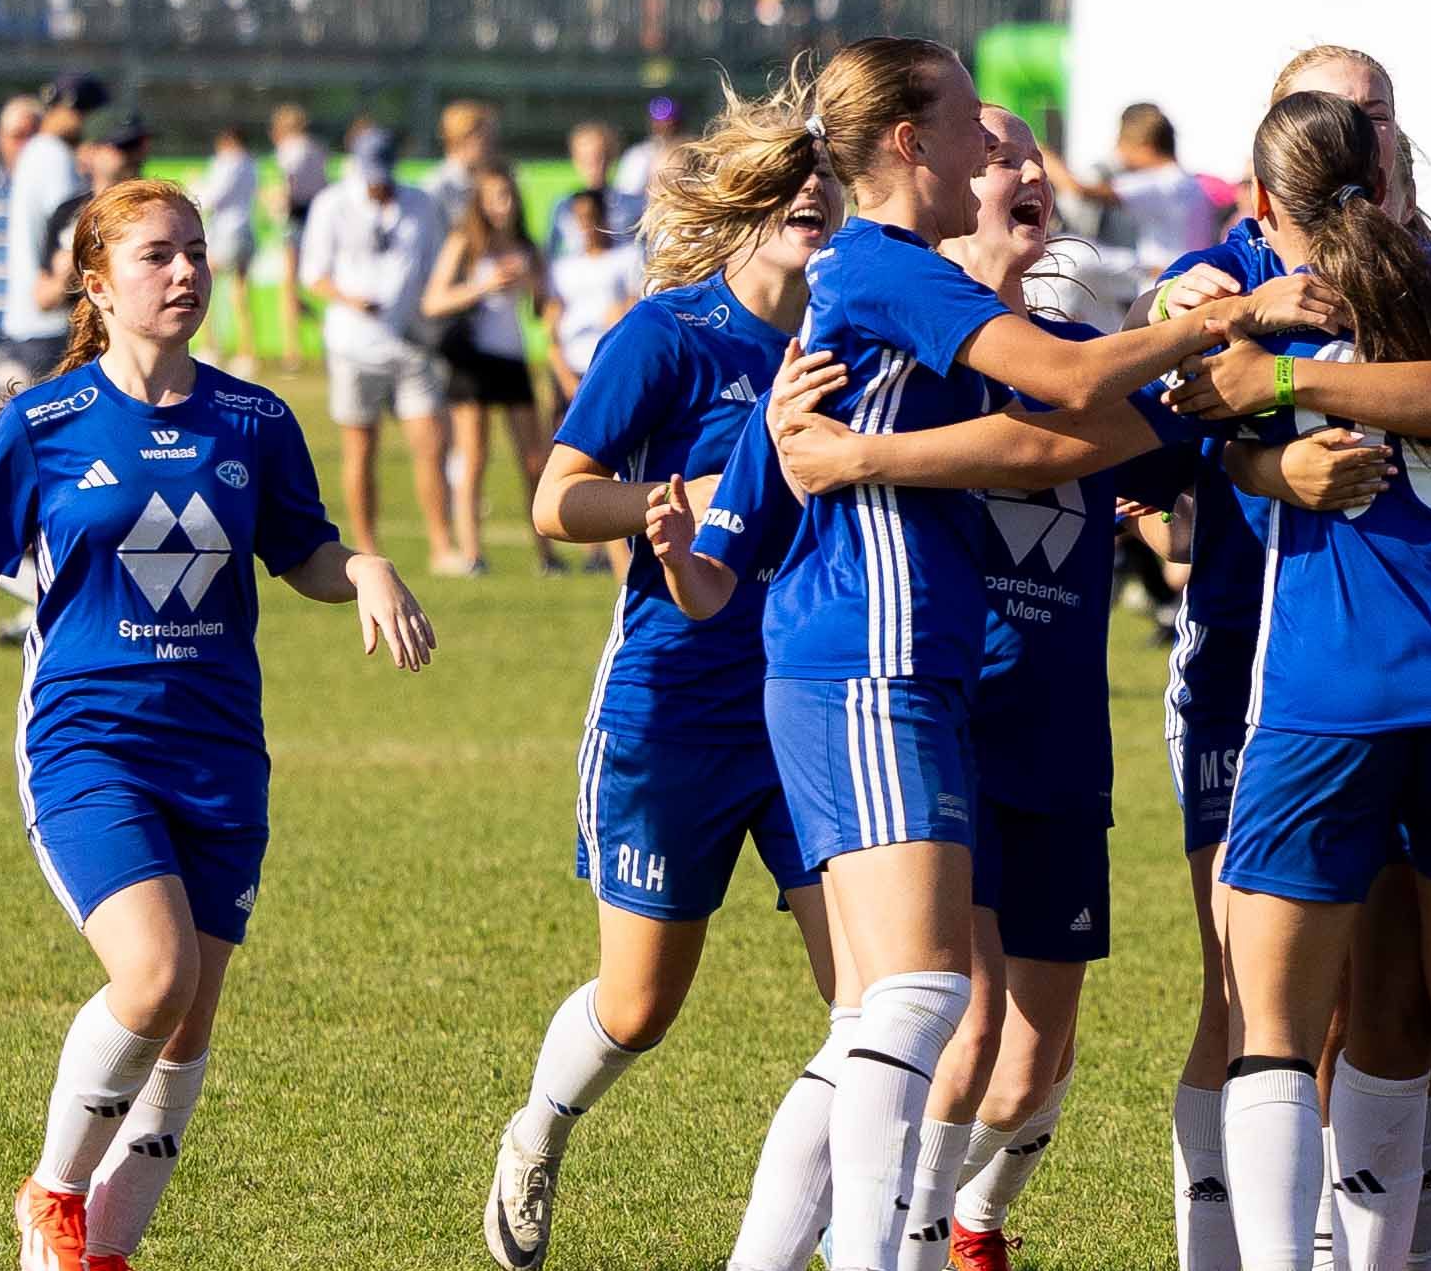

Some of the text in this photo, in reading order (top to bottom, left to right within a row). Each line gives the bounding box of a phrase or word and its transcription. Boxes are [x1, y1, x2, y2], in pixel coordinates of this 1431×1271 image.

[139, 445, 198, 461] wenaas
[985, 575, 1082, 609] parebanken
[1005, 598, 1053, 624] Møre
[118, 619, 224, 642] Sparebanken
[155, 642, 199, 660] Møre
[617, 843, 667, 893] RLH
